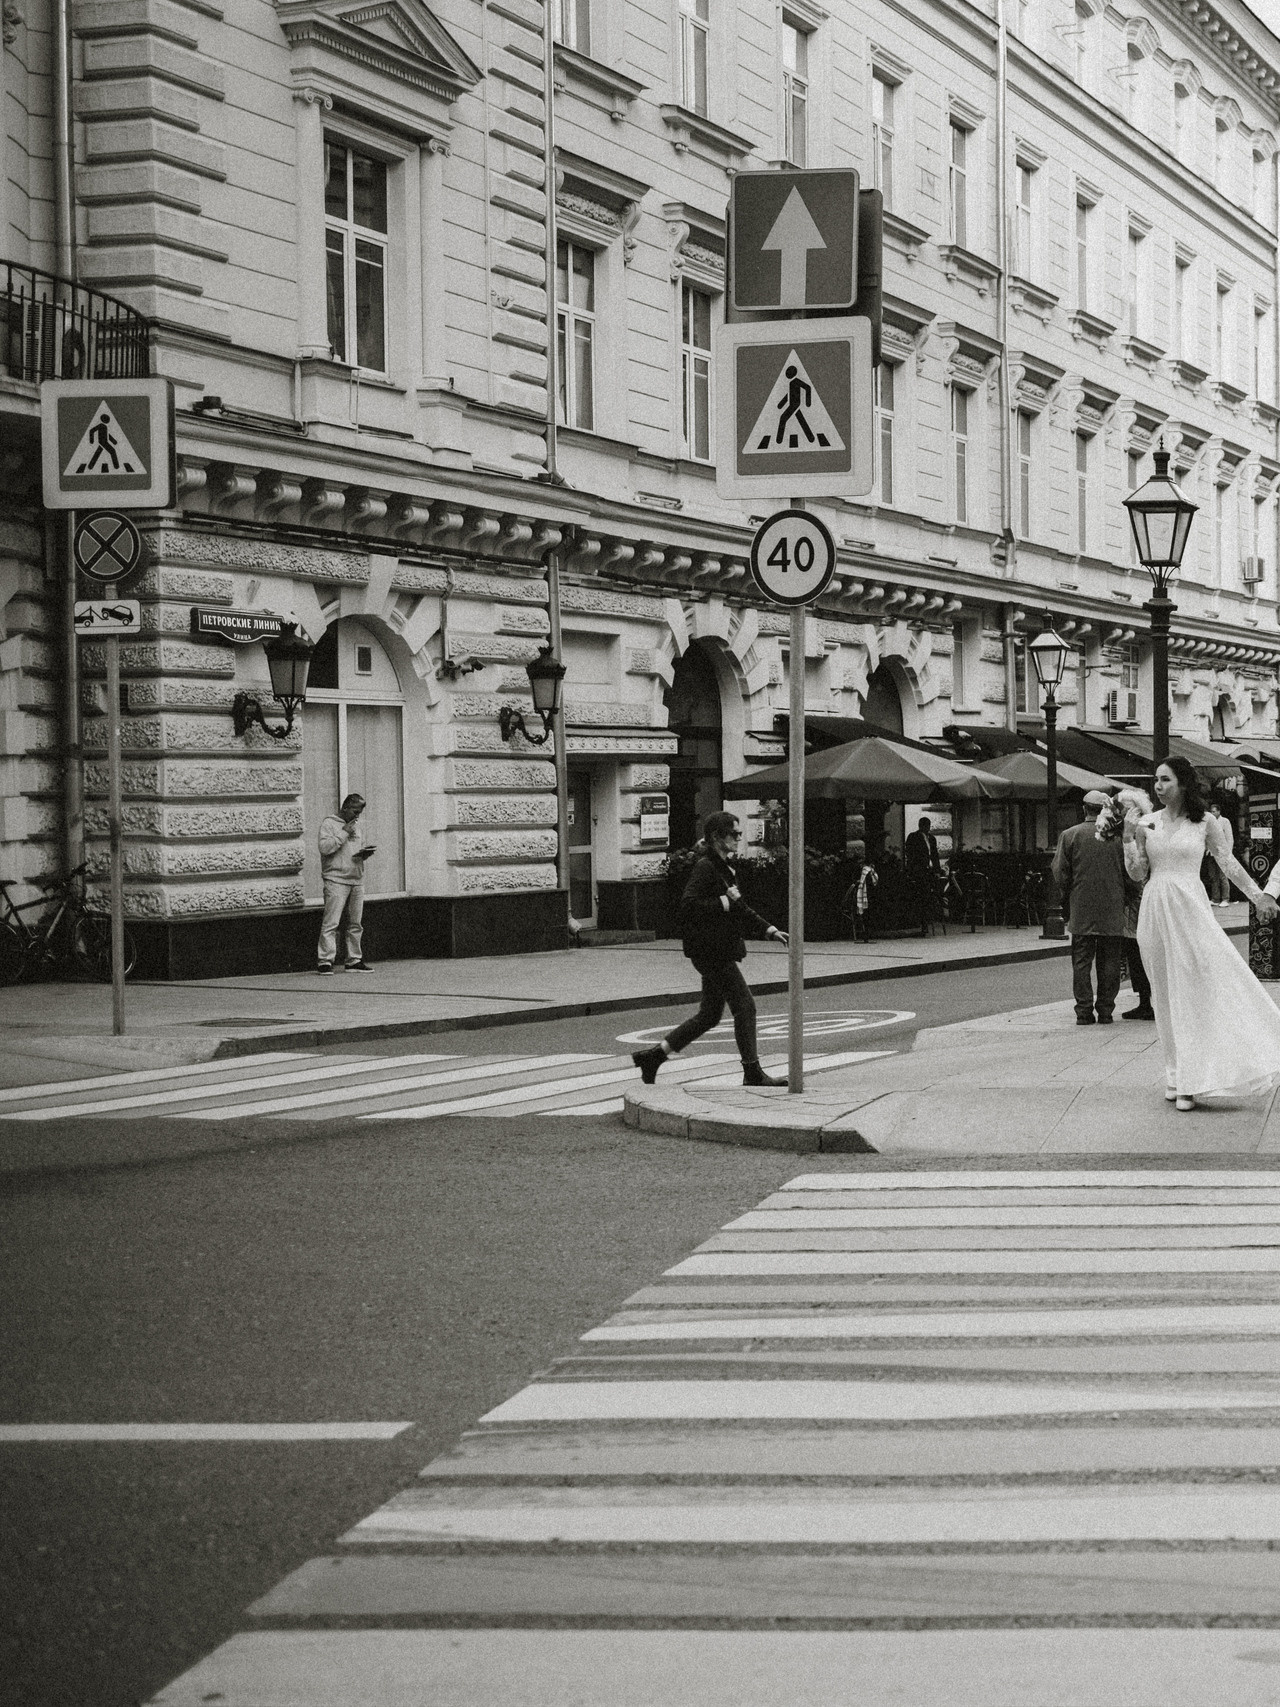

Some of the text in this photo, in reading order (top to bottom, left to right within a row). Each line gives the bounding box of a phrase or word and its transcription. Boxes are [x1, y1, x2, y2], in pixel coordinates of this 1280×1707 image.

[767, 536, 815, 573] 40
[202, 614, 252, 629] ПЕТРОВСКИЕ
[233, 632, 252, 641] УЛИЦА
